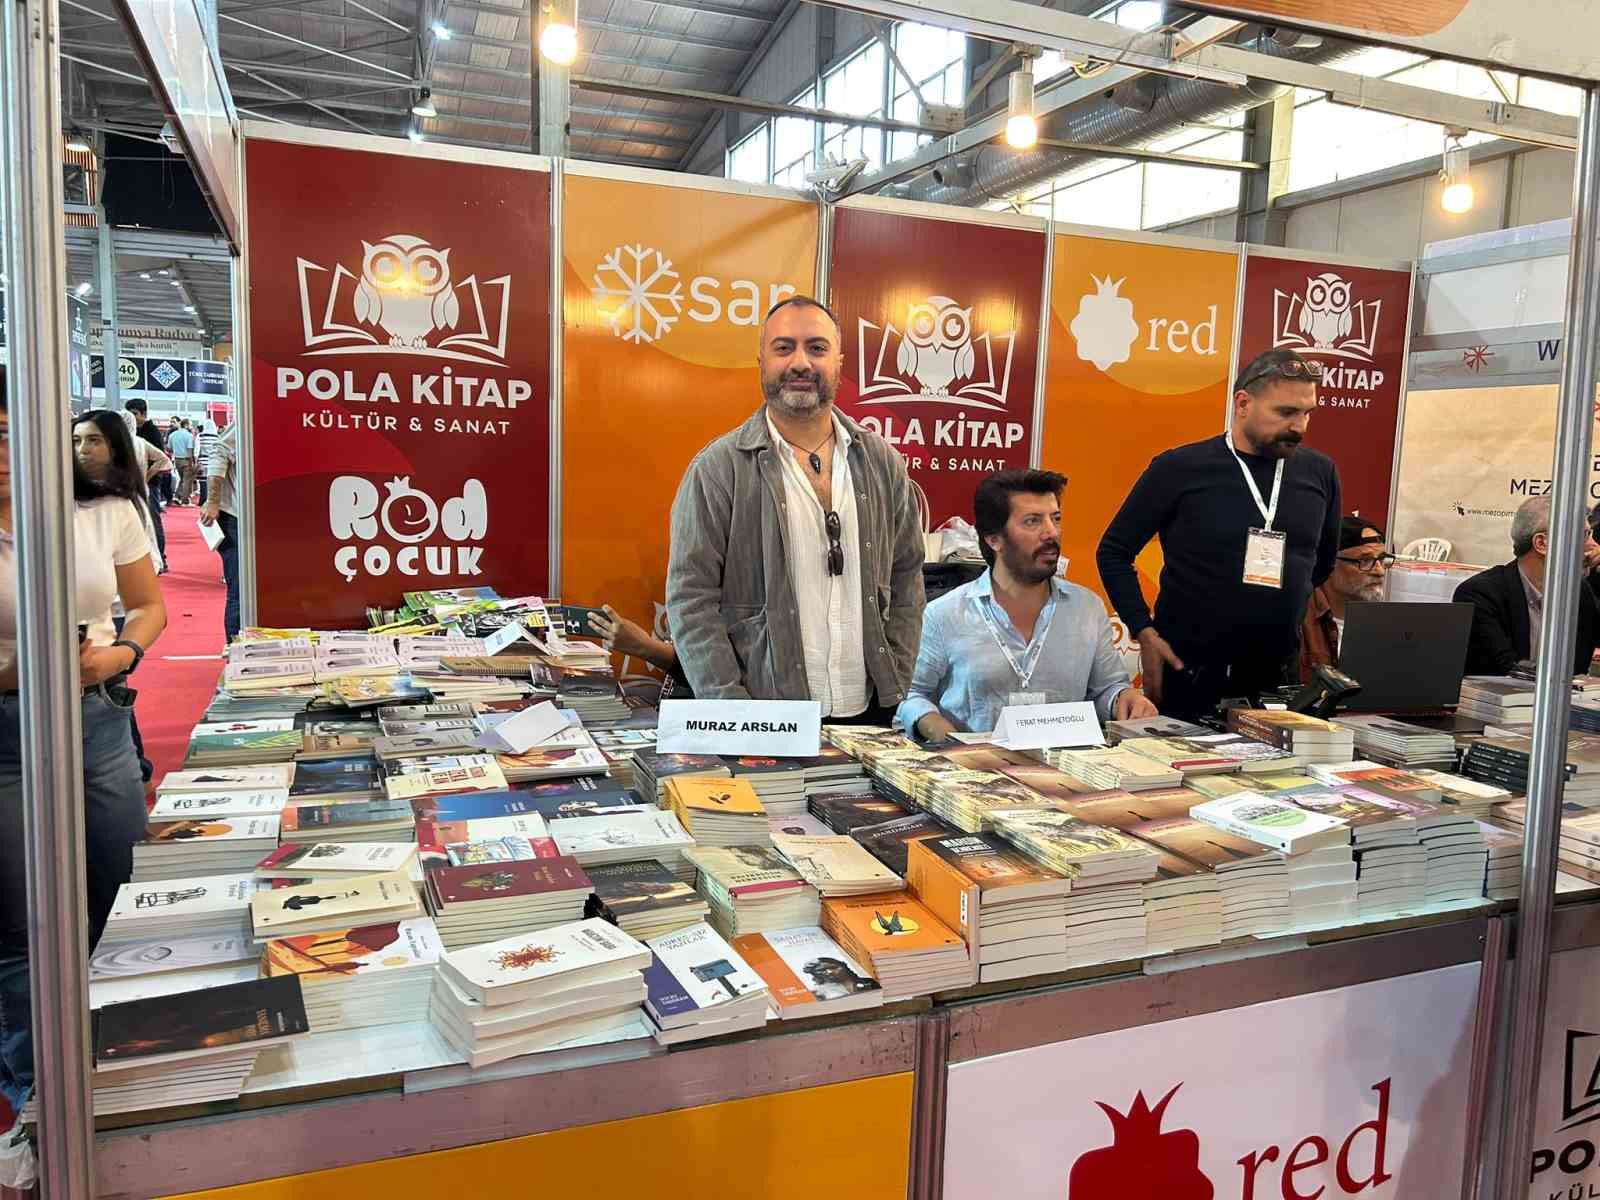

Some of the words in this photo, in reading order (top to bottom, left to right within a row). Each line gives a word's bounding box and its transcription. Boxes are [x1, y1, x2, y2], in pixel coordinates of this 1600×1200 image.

[1145, 304, 1218, 355] red
[276, 367, 401, 403] POLA
[412, 366, 532, 409] KİTAP
[1321, 361, 1385, 391] KİTAP
[1318, 395, 1326, 407] &
[1331, 396, 1371, 409] SANAT
[302, 409, 398, 431] KÜLTÜR
[409, 417, 424, 432] &
[434, 417, 511, 435] SANAT
[850, 416, 925, 446] OLA
[934, 411, 1024, 449] KİTAP
[930, 458, 940, 470] &
[948, 458, 1006, 471] SANAT
[334, 544, 485, 583] ÇOCUK
[686, 720, 737, 732] MURAZ
[740, 721, 798, 733] ARSLAN
[1235, 1076, 1393, 1200] red
[1530, 1139, 1600, 1184] PO
